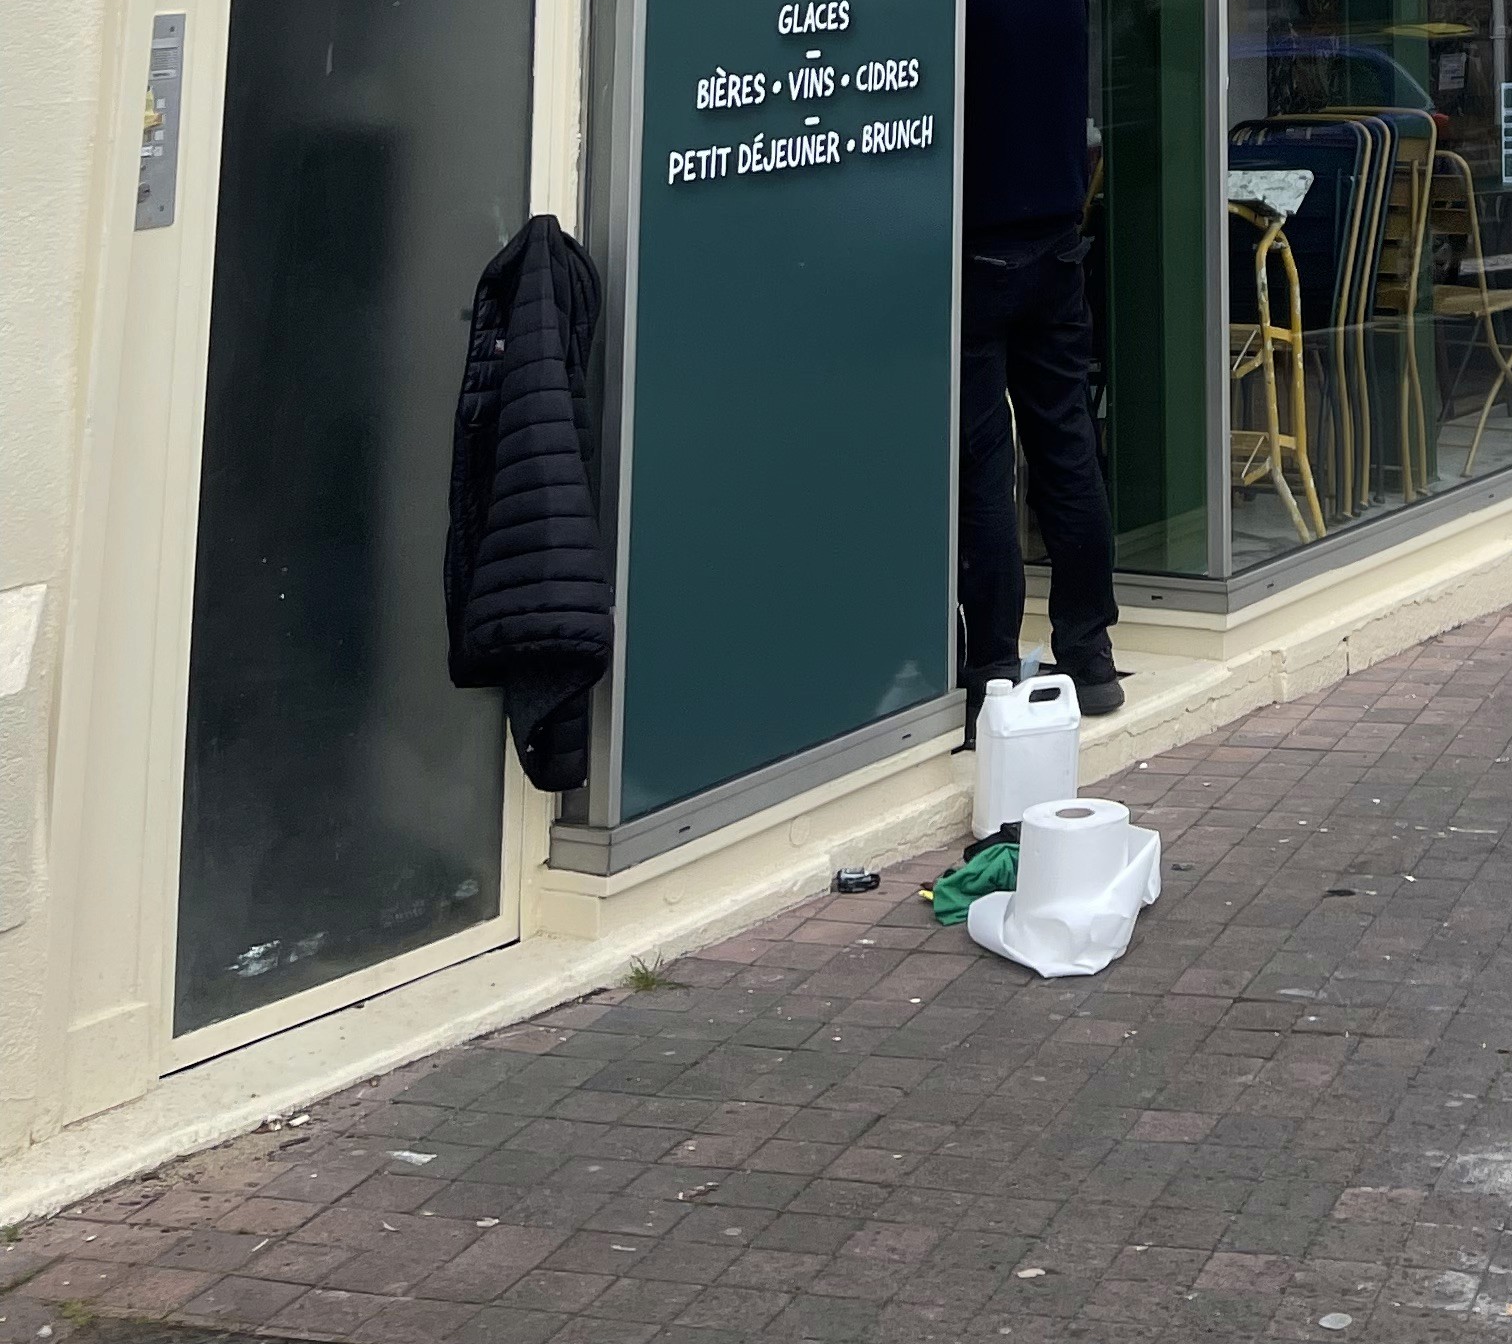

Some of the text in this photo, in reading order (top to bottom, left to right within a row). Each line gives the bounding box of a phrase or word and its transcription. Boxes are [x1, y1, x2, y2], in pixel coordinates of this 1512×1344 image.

[779, 1, 849, 34] GLACES
[697, 59, 918, 108] BIÈRES VINS CIDRES
[669, 116, 932, 184] PETIT DÉJEUNER BRUNCH
